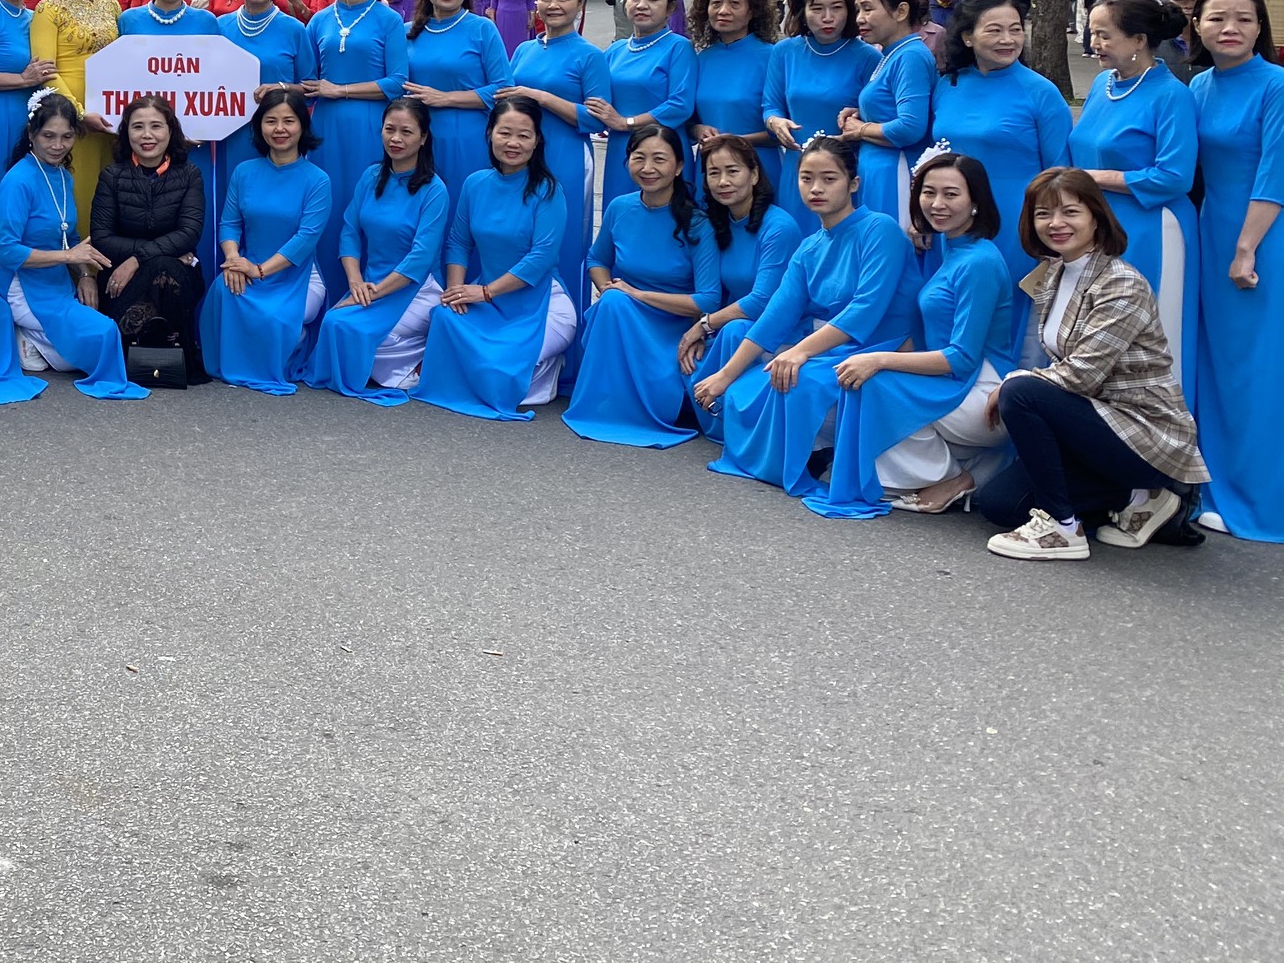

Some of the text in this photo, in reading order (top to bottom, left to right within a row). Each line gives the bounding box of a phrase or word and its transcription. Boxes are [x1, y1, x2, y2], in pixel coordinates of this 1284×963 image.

[147, 53, 200, 77] QUẬN
[102, 86, 246, 117] THH XUÂN
